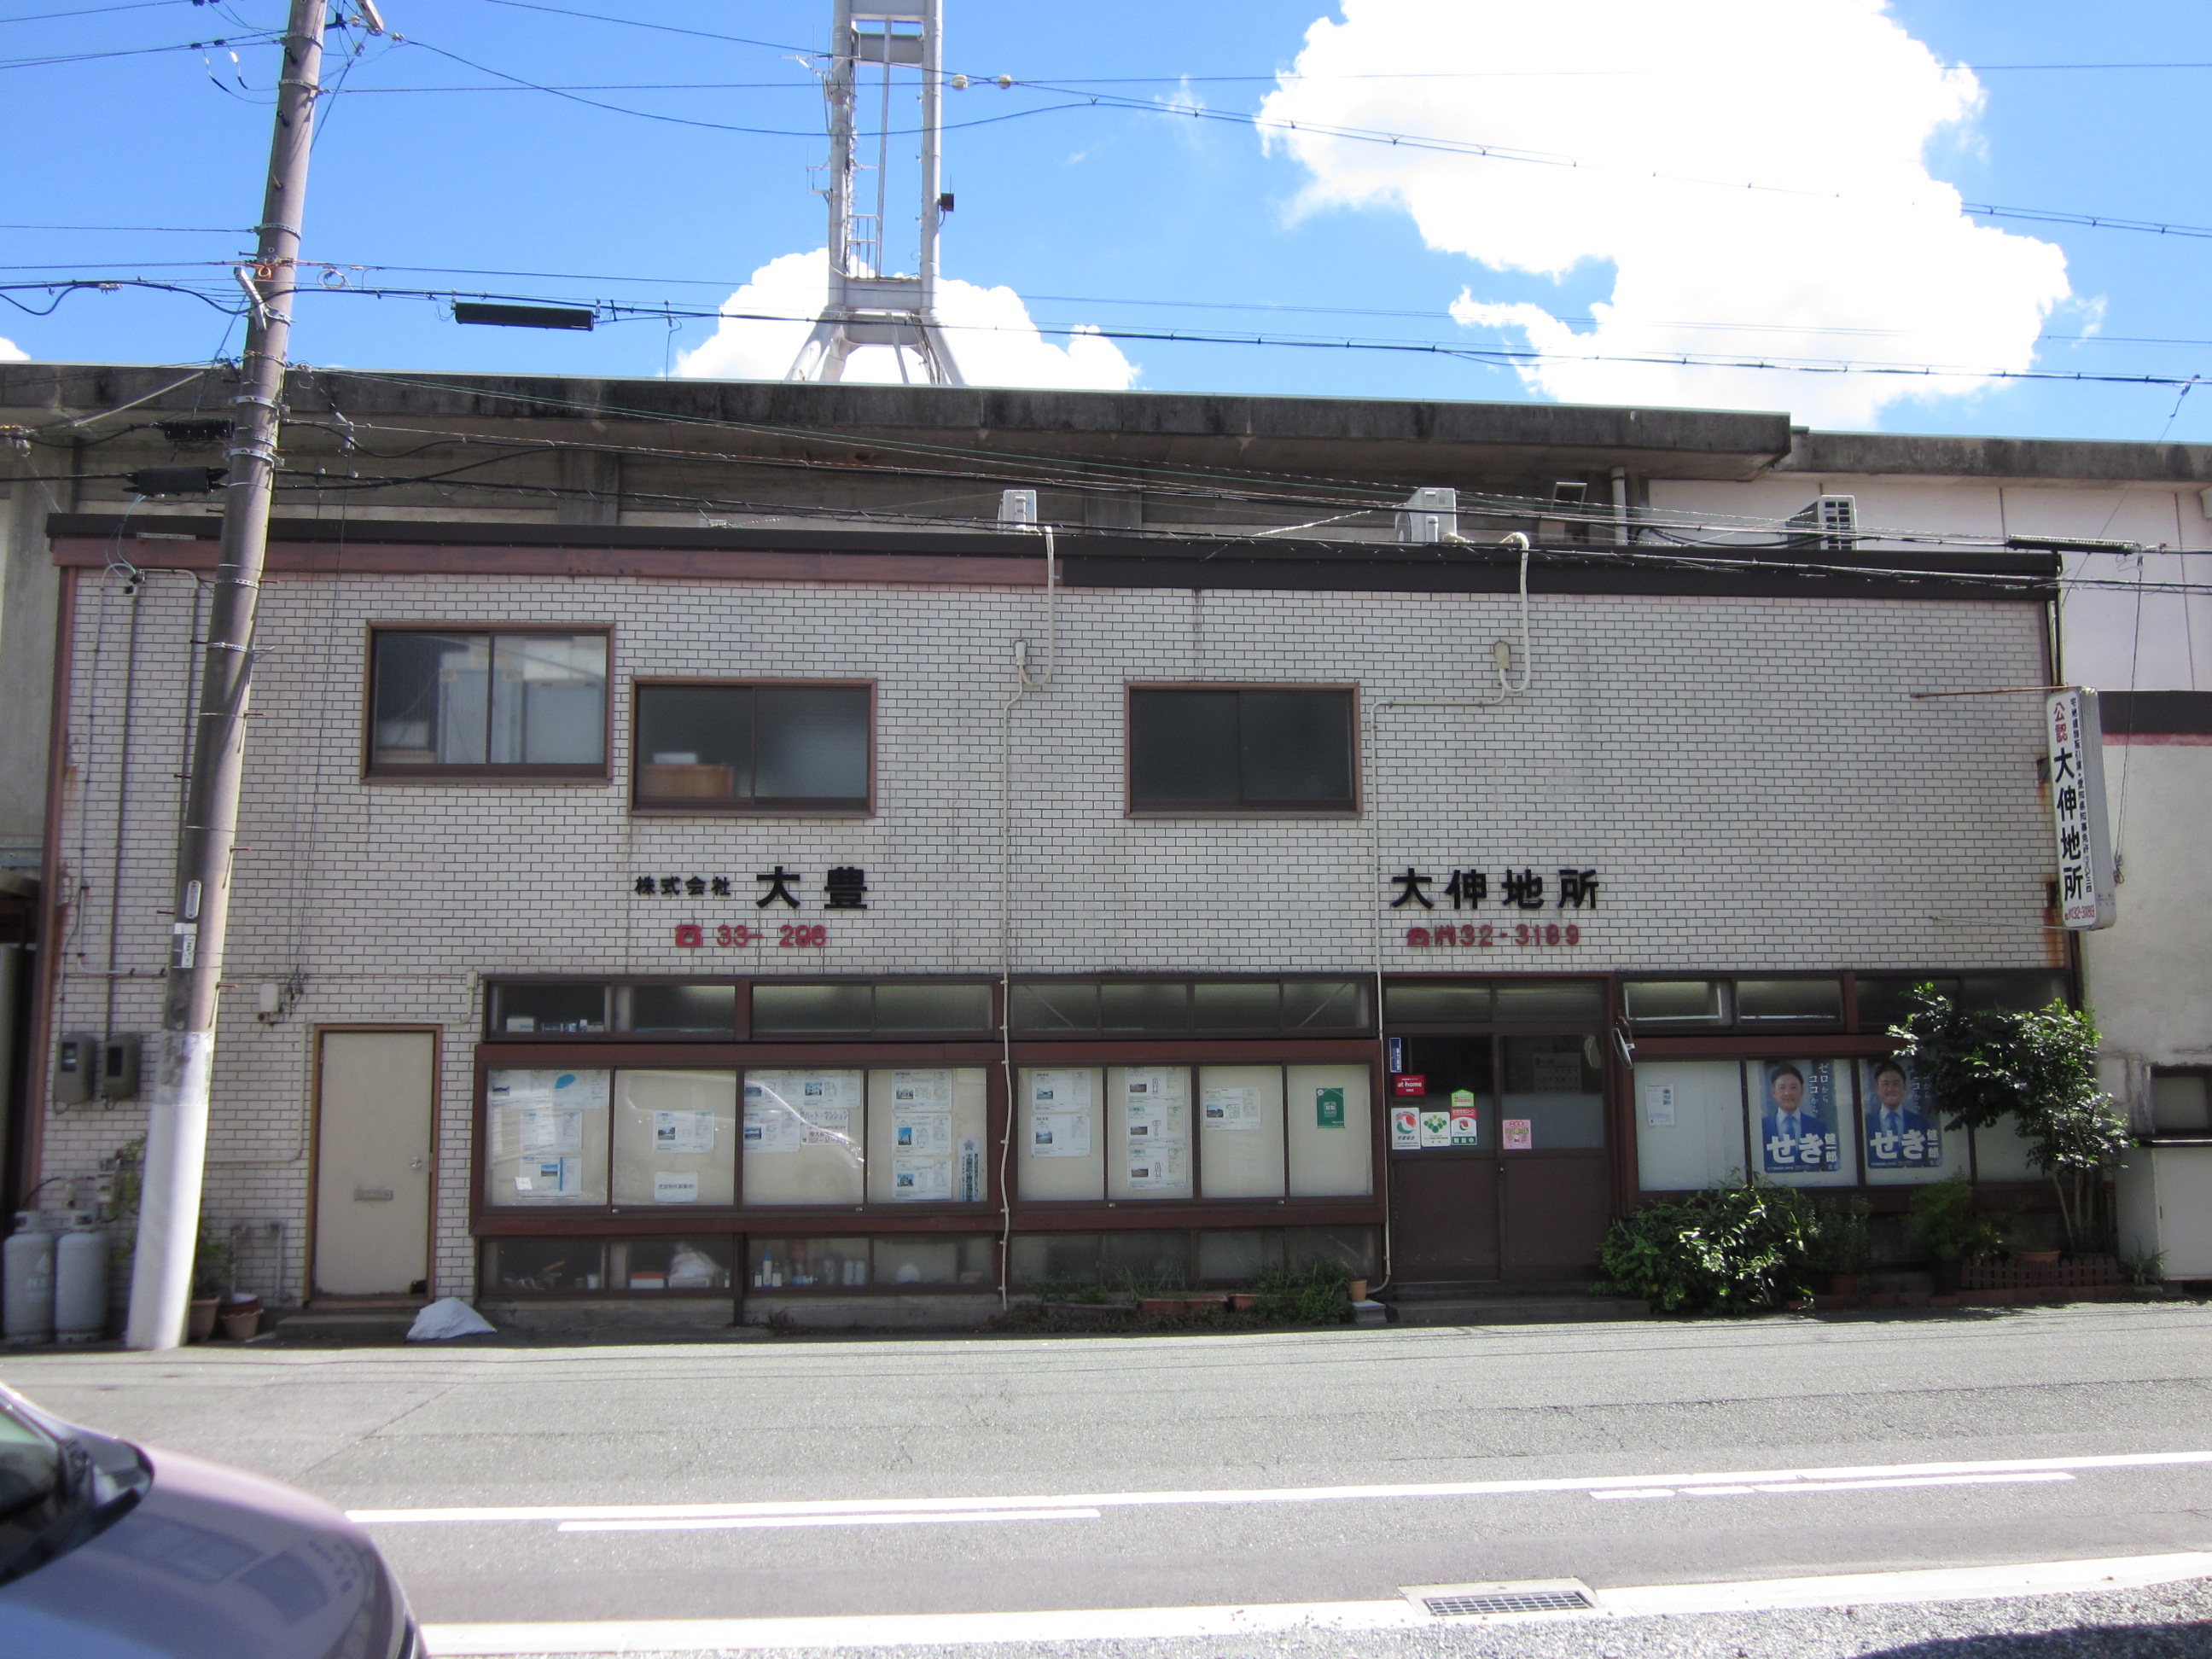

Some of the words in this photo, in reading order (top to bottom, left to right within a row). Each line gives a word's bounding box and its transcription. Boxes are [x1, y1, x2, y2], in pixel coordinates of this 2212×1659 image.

[2053, 701, 2068, 743] 公認
[2053, 748, 2082, 901] 大伸地所
[634, 876, 731, 896] 株式会社
[756, 866, 868, 909] 大豊
[1391, 868, 1599, 910] 大伸地所
[1809, 1075, 1819, 1114] ココから
[1819, 1062, 1829, 1103] ゼロから
[1767, 1132, 1824, 1164] せき
[1825, 1132, 1837, 1162] 健一郎
[1870, 1129, 1925, 1160] せき
